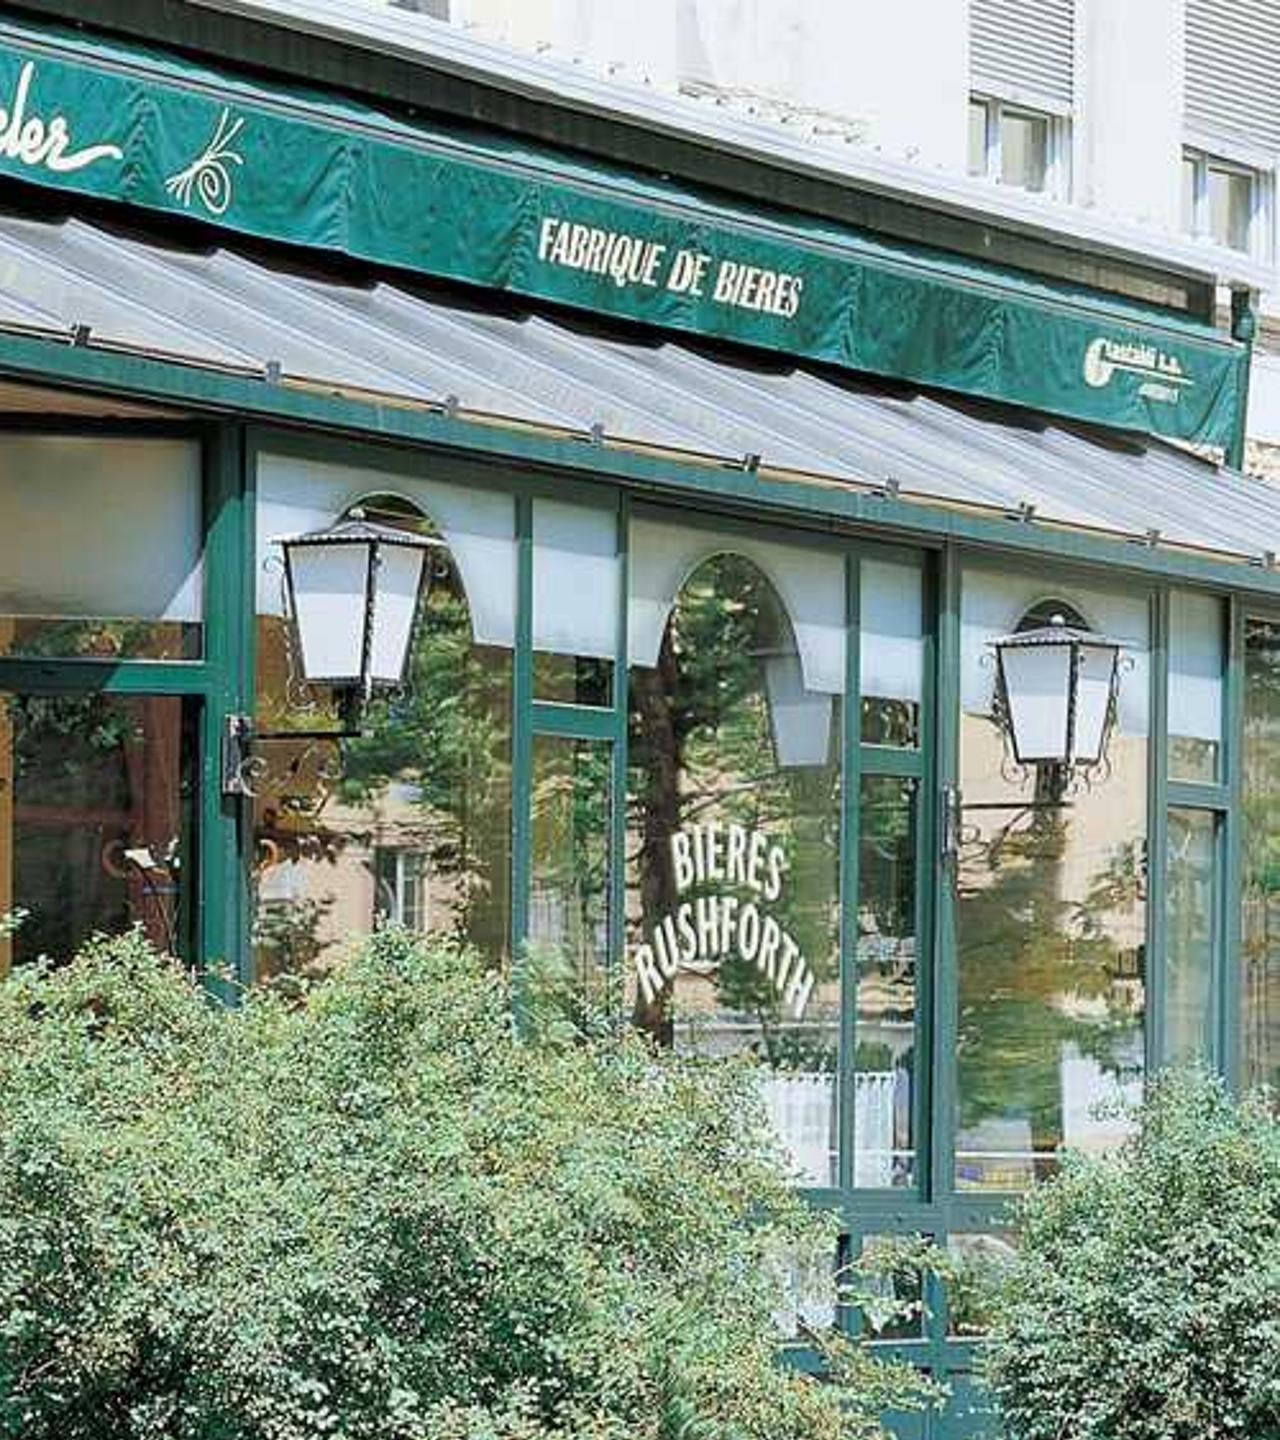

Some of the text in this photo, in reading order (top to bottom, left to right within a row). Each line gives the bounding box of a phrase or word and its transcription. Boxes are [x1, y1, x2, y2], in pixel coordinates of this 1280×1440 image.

[538, 217, 803, 318] FABRIQUE DE BIERES
[671, 822, 785, 900] BIERES
[635, 896, 815, 1018] RUSHFORTH
